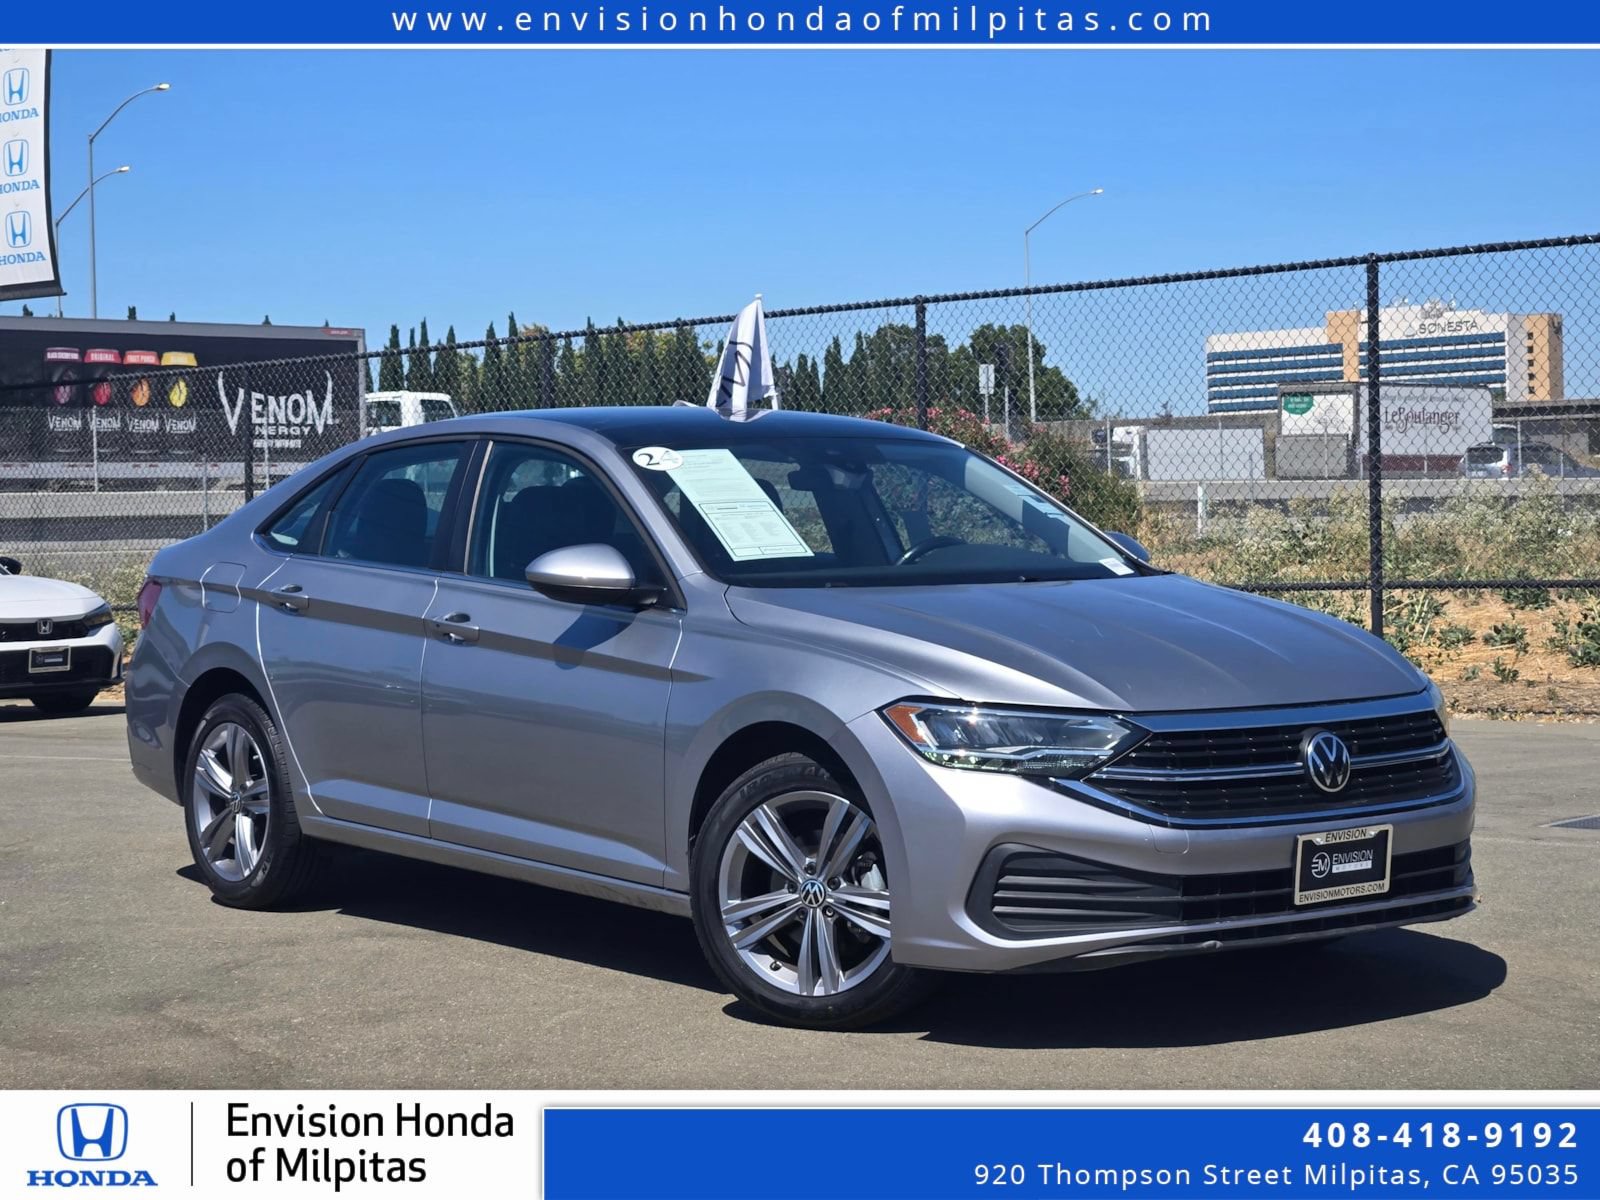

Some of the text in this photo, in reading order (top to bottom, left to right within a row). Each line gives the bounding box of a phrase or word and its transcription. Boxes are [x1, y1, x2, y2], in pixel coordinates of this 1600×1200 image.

[0, 107, 39, 122] ONDA
[1418, 321, 1478, 334] SONESTA
[217, 371, 335, 436] VENOM
[48, 411, 82, 431] VENOM
[126, 413, 160, 432] VENOM
[249, 425, 311, 436] NERGY
[1325, 828, 1368, 843] ENVISION
[1332, 849, 1374, 865] ENVISION
[1299, 883, 1385, 903] ENVISIONMOTORS.COM
